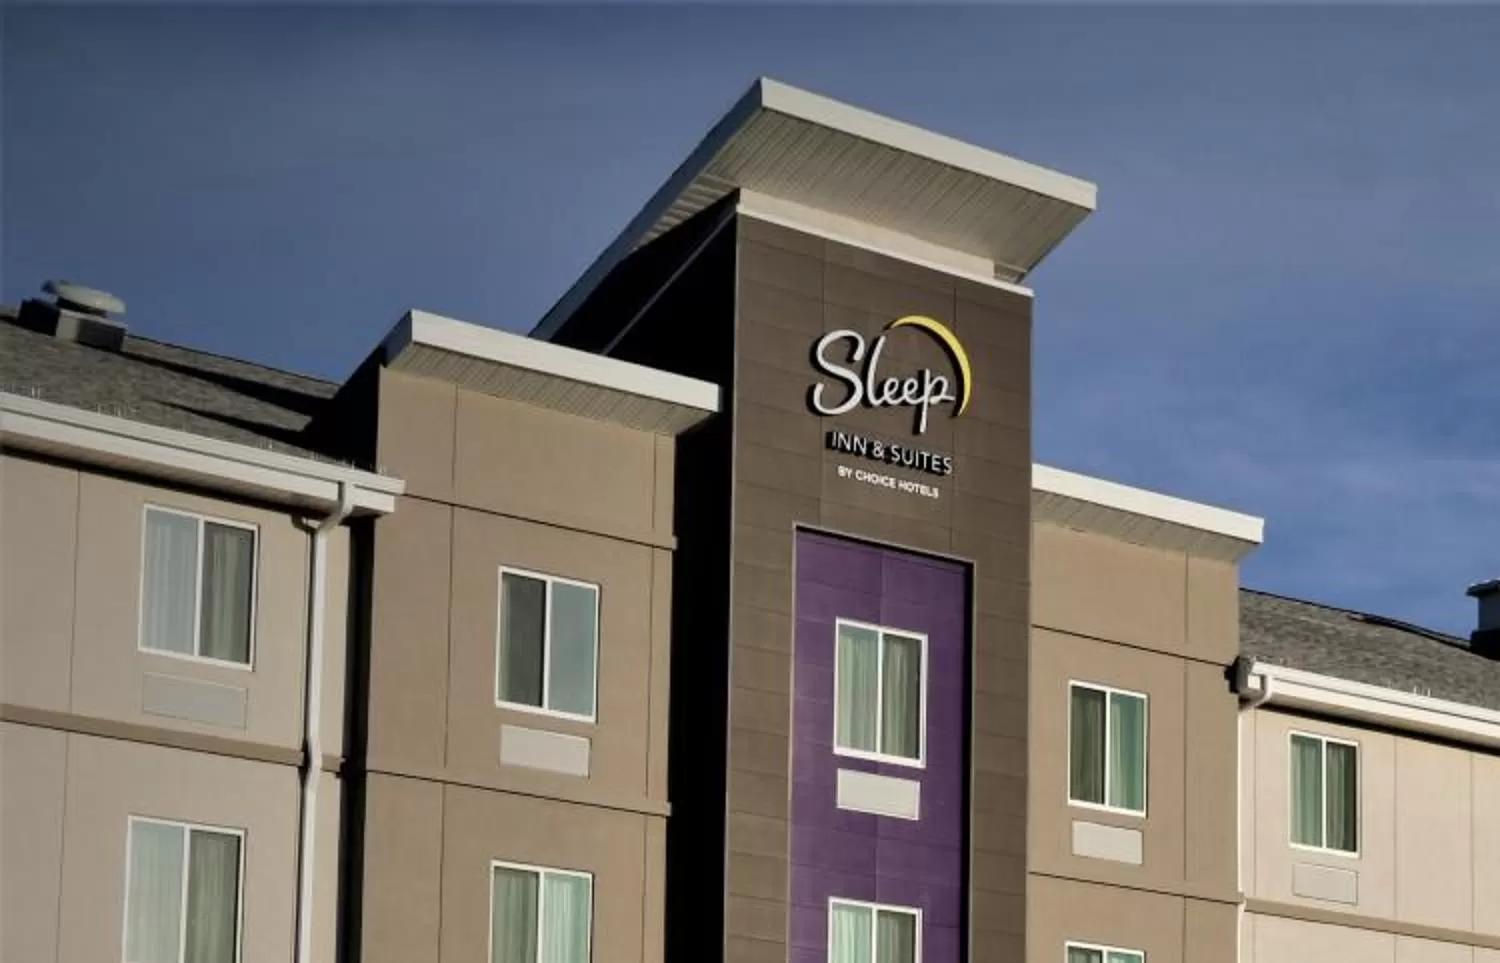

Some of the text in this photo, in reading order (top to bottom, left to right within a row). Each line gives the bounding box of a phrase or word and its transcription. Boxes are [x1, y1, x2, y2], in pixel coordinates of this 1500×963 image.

[813, 329, 957, 434] Sleep
[831, 431, 953, 476] INN & SUITES
[837, 464, 940, 499] BY CHOICE HOTELS
